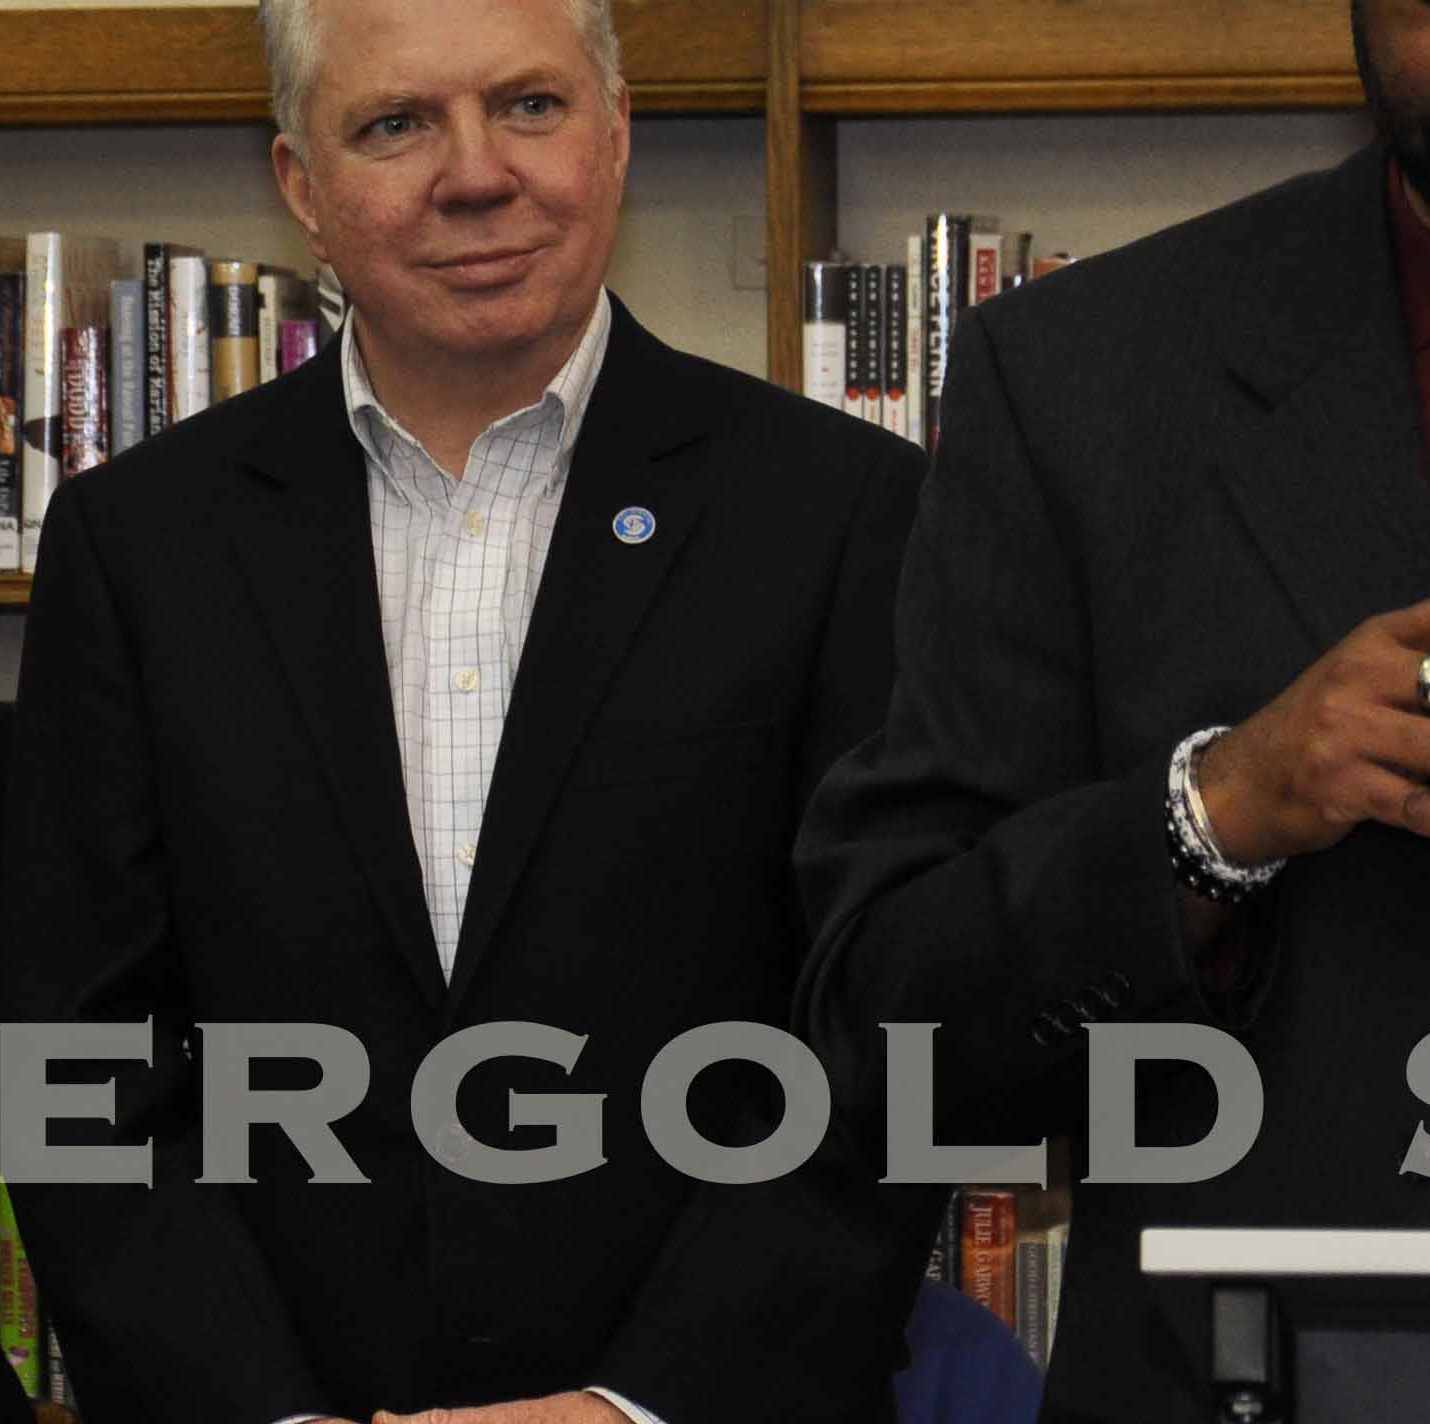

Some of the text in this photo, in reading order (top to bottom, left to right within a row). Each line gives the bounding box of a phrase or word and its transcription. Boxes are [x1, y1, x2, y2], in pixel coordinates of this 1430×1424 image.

[147, 258, 163, 287] The
[148, 355, 163, 372] of
[929, 314, 950, 398] FLYNN
[970, 1205, 994, 1245] JULIE
